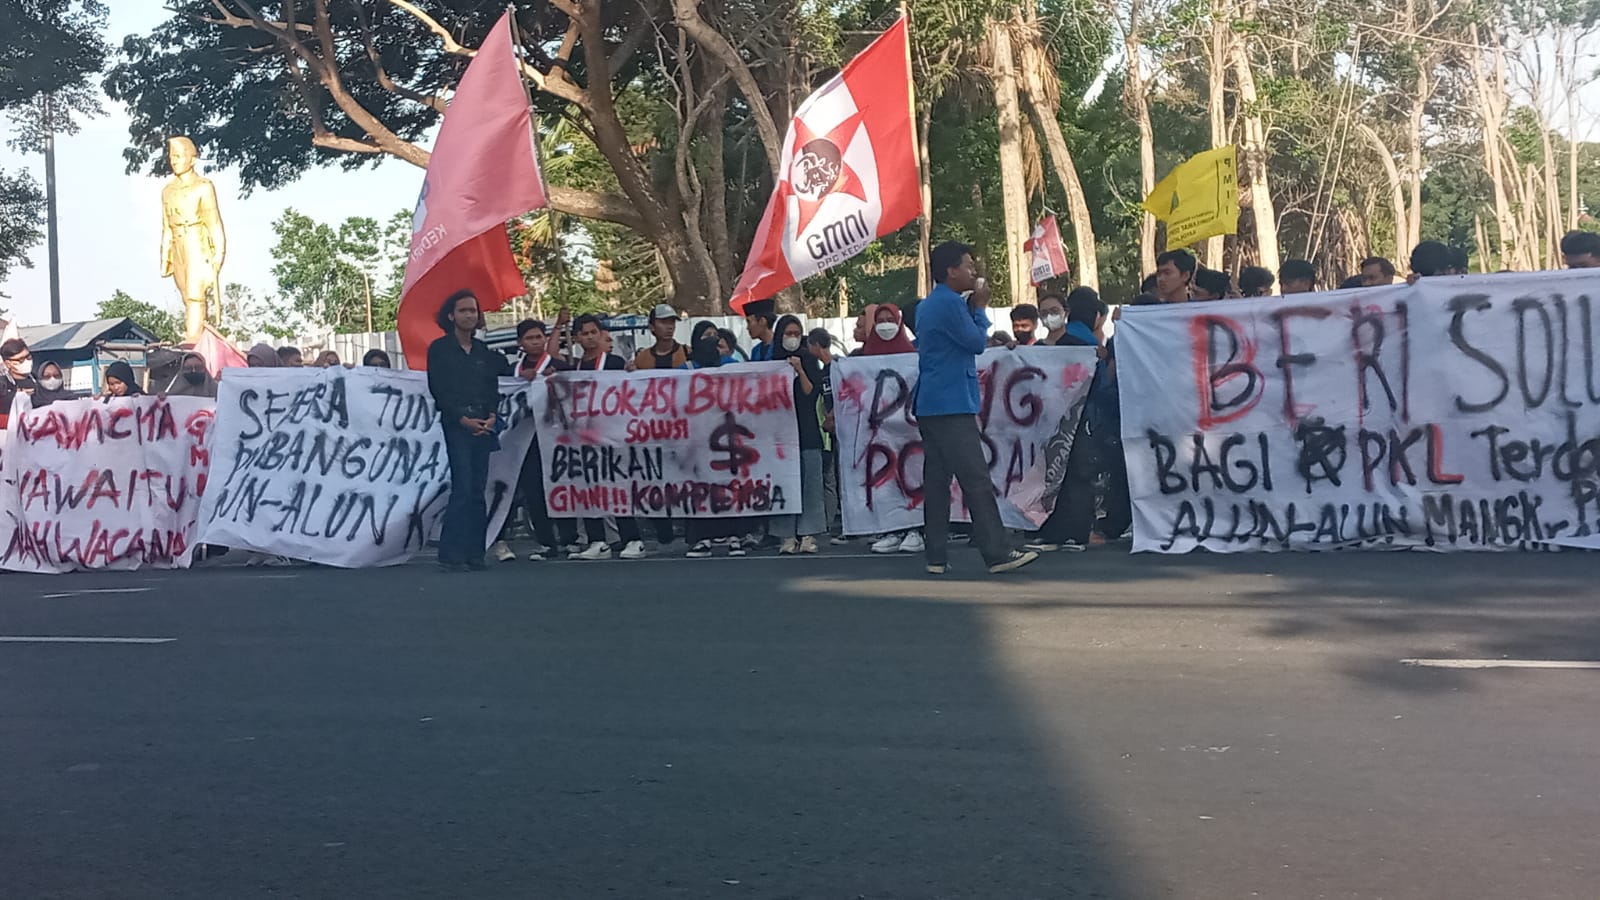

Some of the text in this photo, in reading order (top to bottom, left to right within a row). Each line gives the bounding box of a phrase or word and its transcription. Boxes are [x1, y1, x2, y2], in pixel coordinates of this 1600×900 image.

[1189, 299, 1411, 431] BERI
[684, 373, 793, 416] BUKAN
[624, 417, 689, 443] SOLUSI
[550, 445, 663, 483] BERIKAN
[1146, 427, 1272, 494] BAGI
[1359, 424, 1464, 491] PKL
